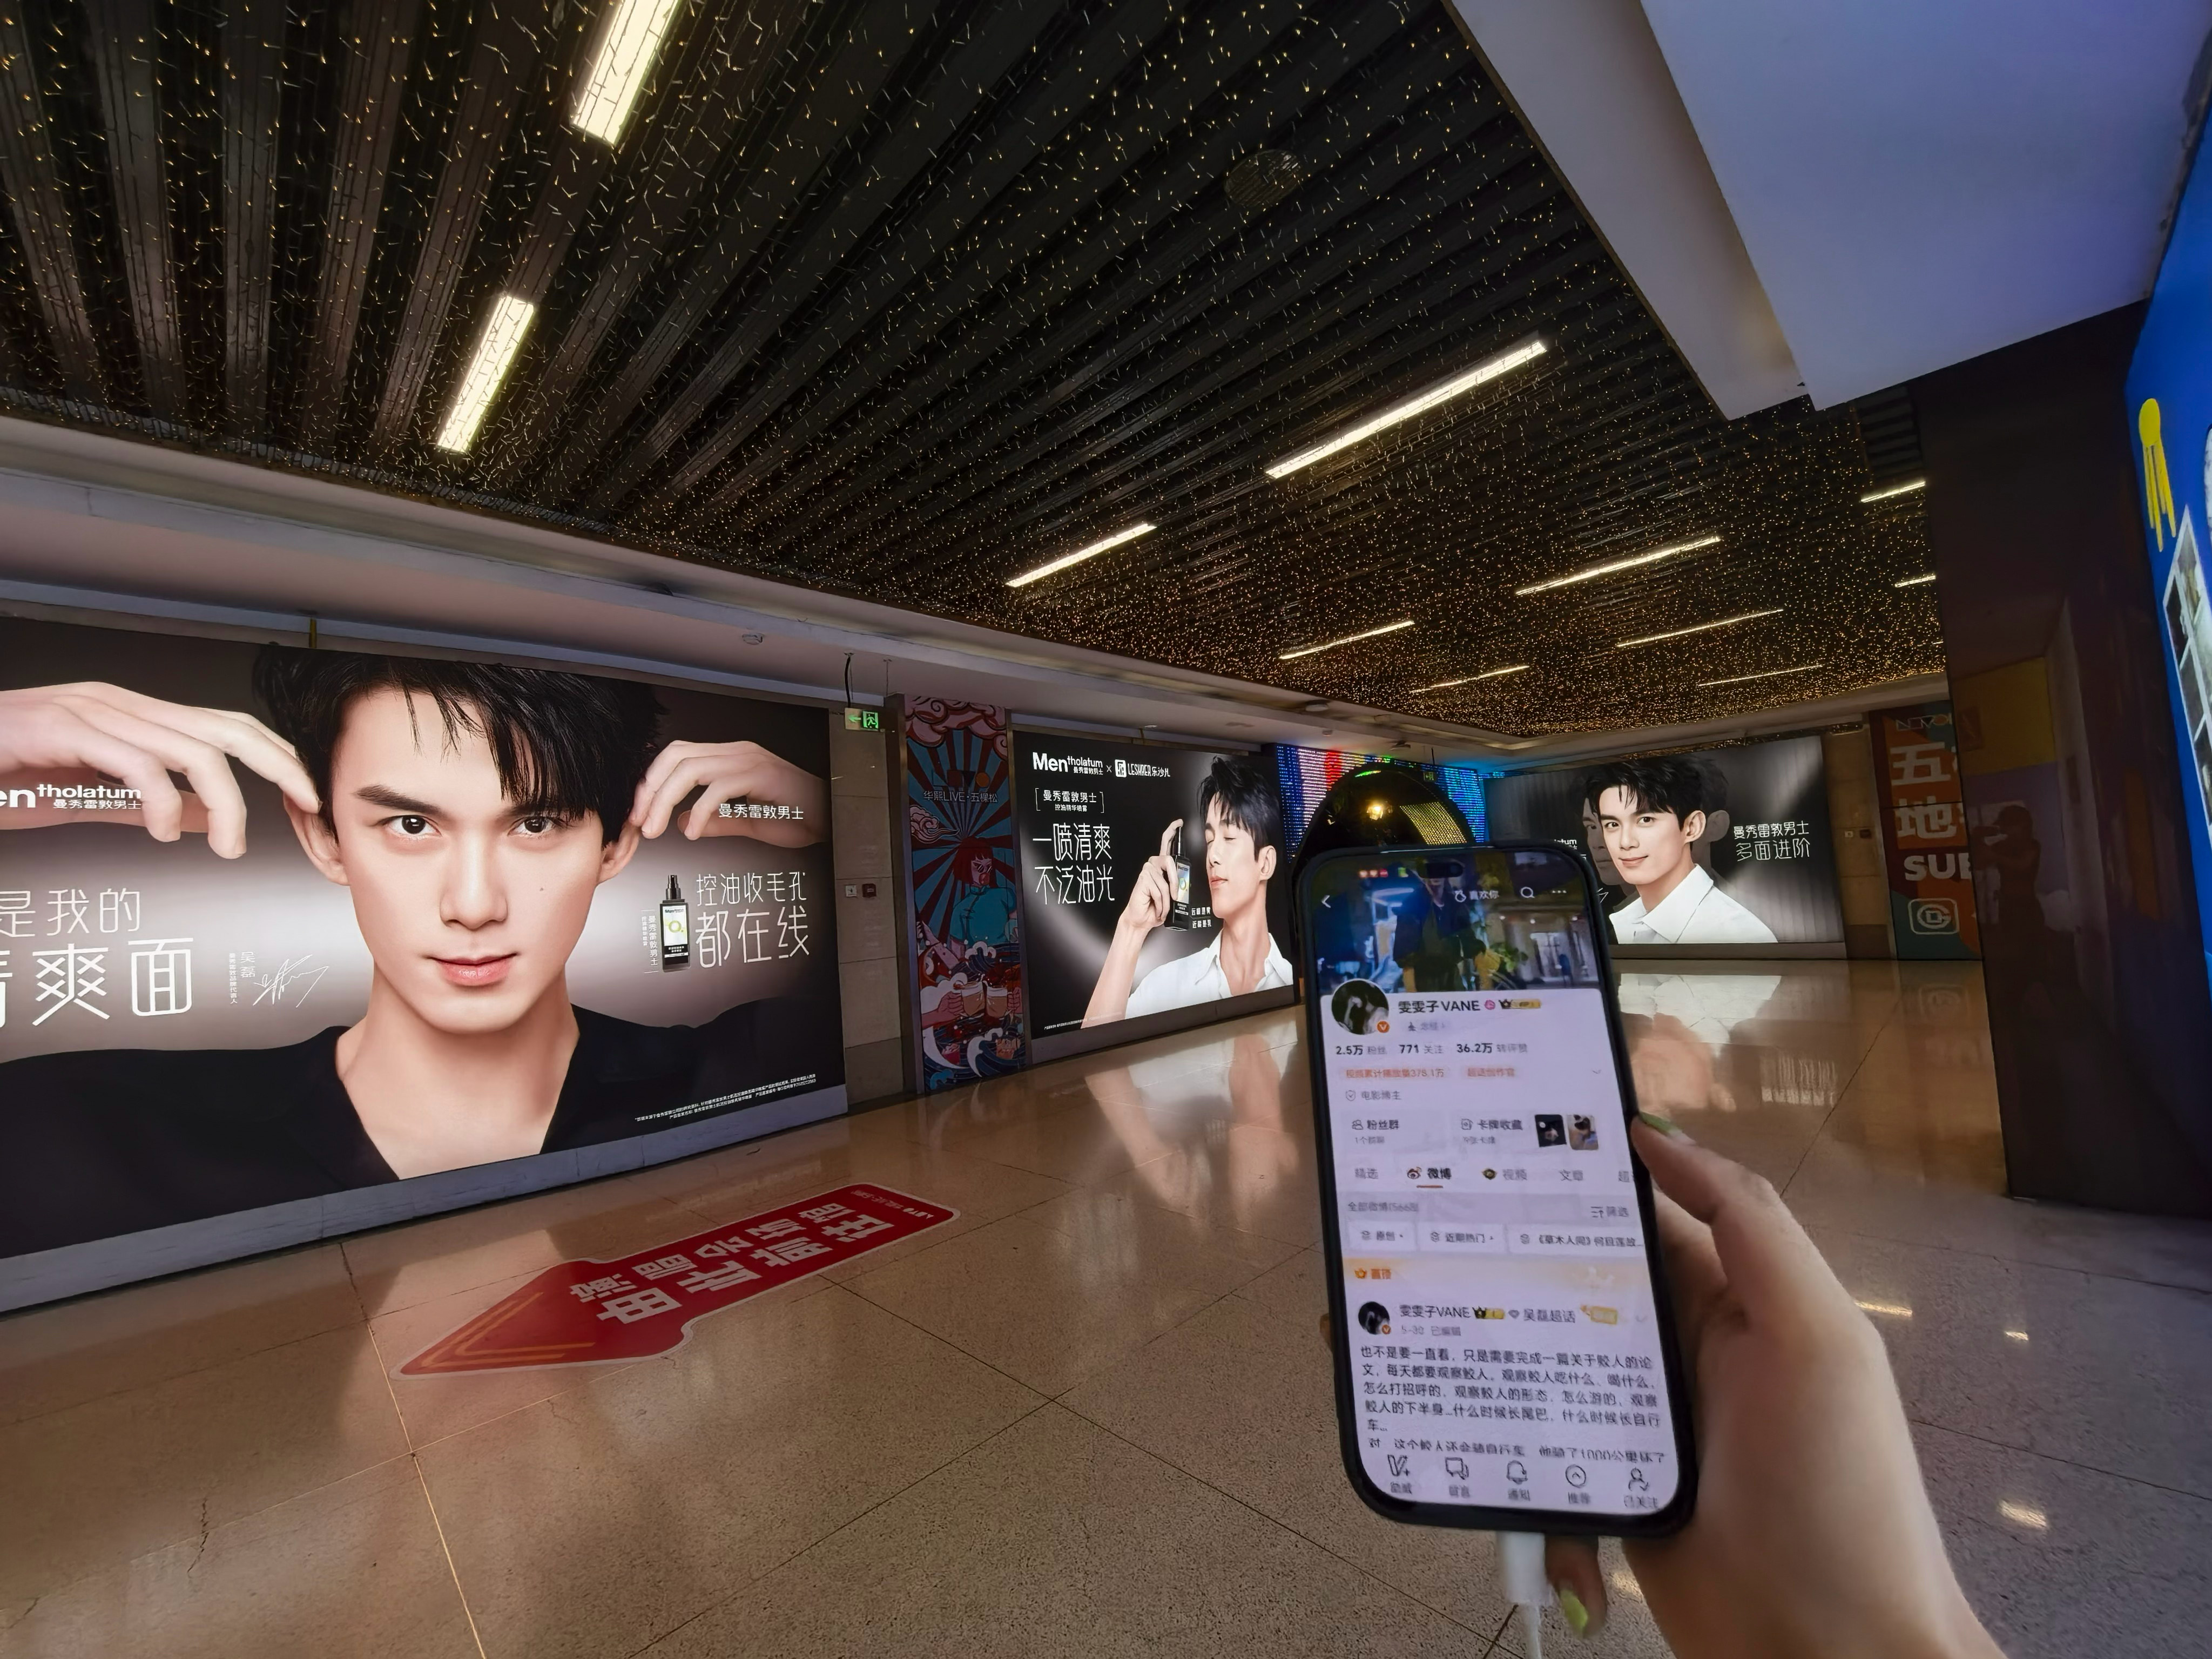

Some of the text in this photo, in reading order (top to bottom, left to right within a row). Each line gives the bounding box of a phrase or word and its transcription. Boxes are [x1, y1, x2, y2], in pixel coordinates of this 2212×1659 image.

[1891, 742, 1958, 786] 五
[53, 799, 141, 809] 曼秀雷敦男士
[718, 803, 804, 820] 曼秀雷敦男士
[1043, 790, 1097, 803] 曼秀雷敦男士
[1734, 820, 1809, 840] 曼秀雷敦男士
[1894, 795, 1965, 839] 地
[1033, 822, 1112, 861] 一喷清爽
[1736, 838, 1810, 861] 多面进阶
[697, 872, 807, 906] 控油收毛孔
[1034, 864, 1115, 905] 不泛油光
[0, 888, 140, 937] 是我的
[649, 915, 658, 966] 曼秀雷敦男士
[696, 906, 809, 968] 都在线
[241, 952, 255, 978] 吴磊
[1336, 1045, 1363, 1055] 2.5万
[1399, 1044, 1419, 1054] 771
[1456, 1043, 1493, 1053] 36.2万
[1427, 1168, 1452, 1179] 微博
[596, 1215, 894, 1324] 由此前往
